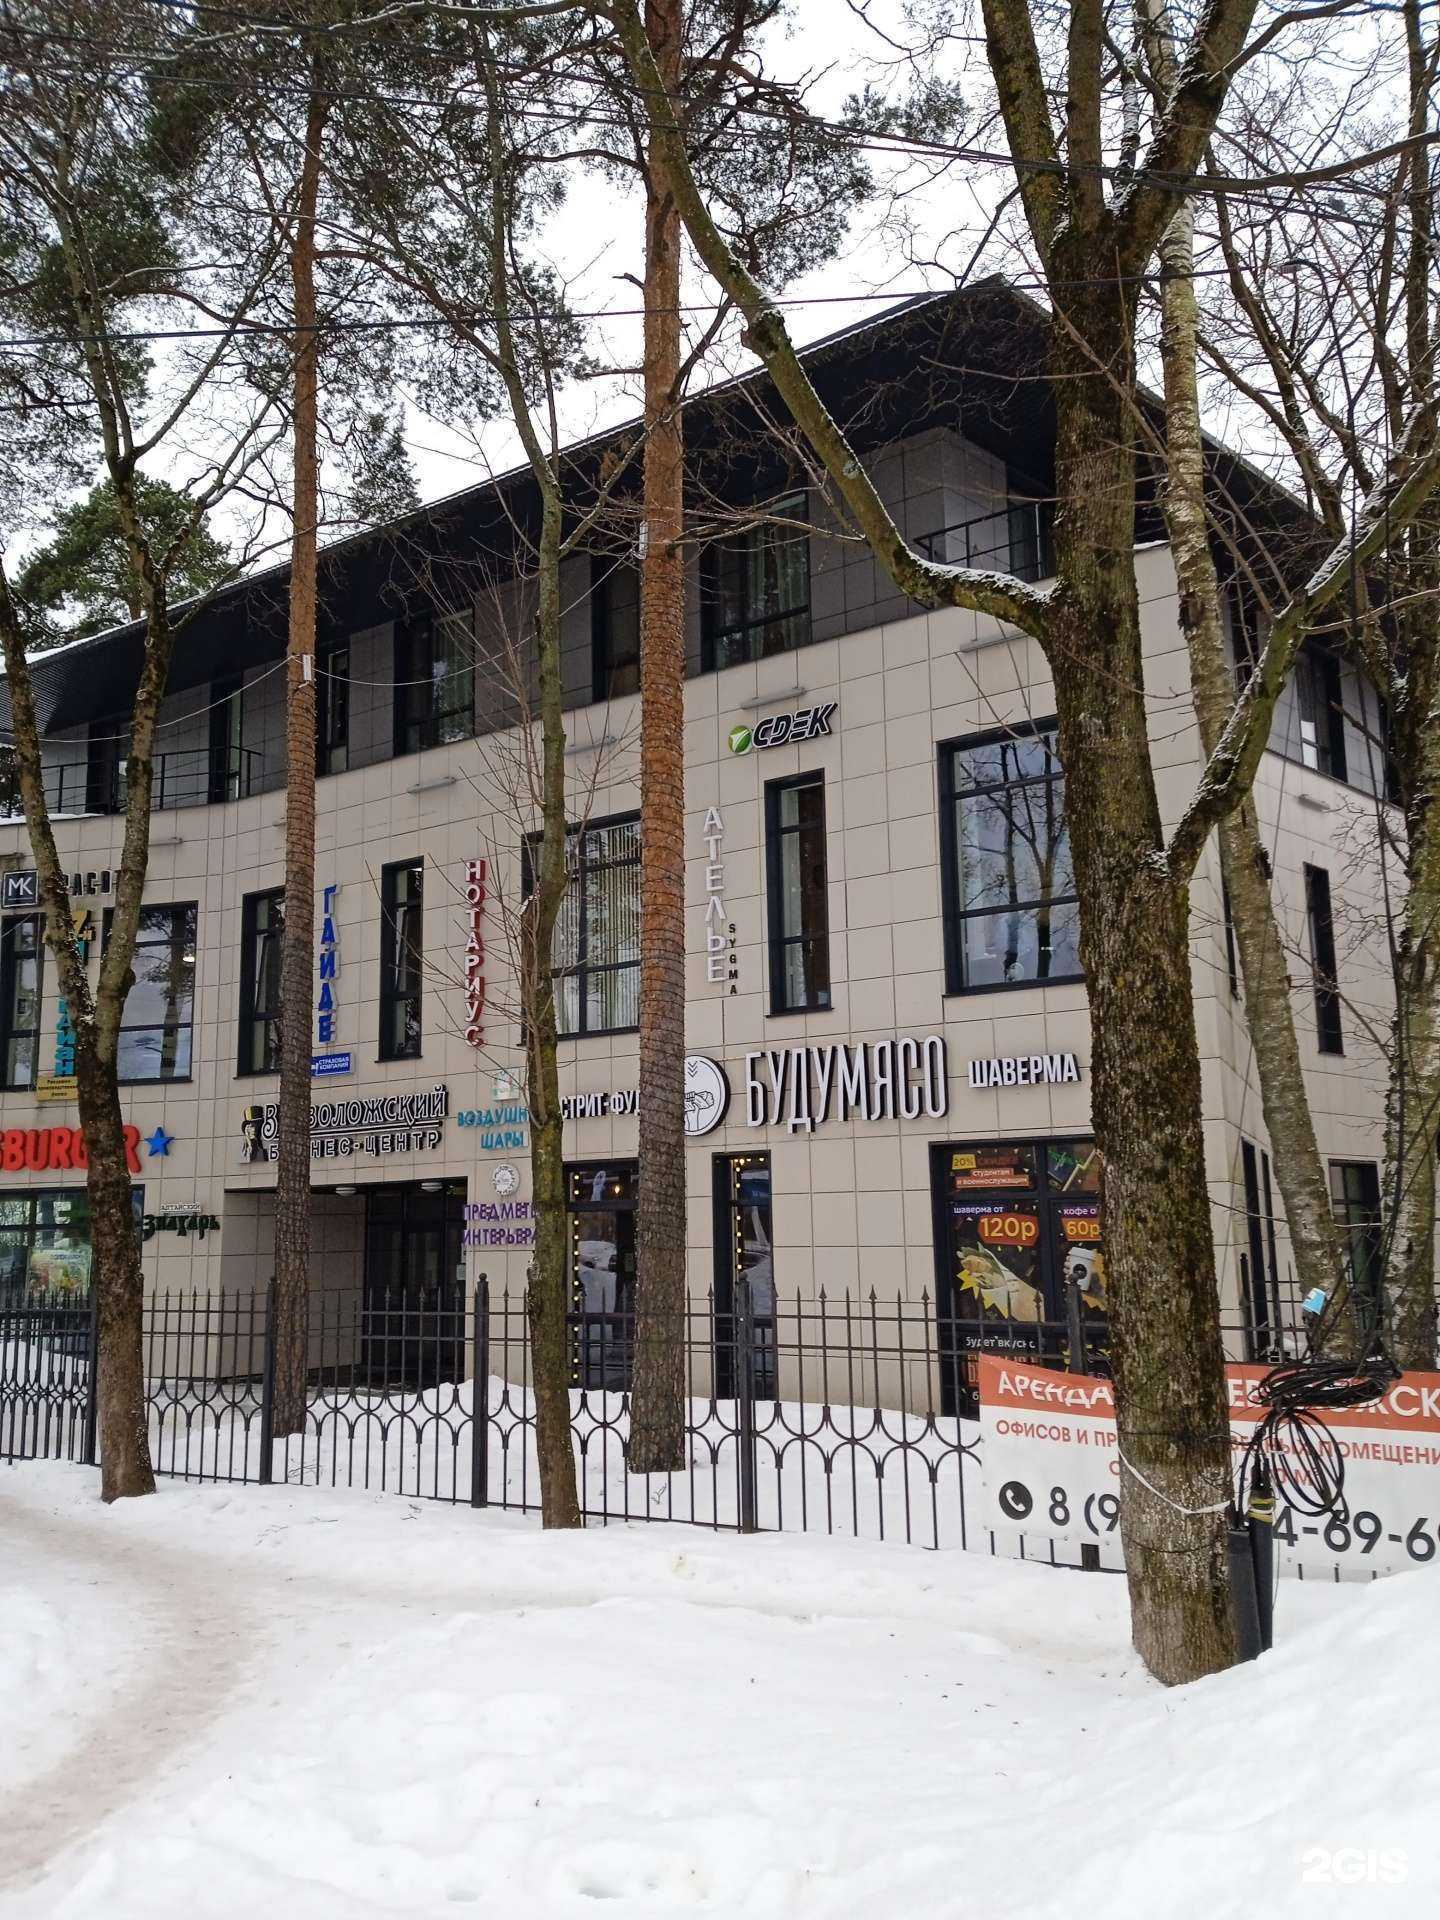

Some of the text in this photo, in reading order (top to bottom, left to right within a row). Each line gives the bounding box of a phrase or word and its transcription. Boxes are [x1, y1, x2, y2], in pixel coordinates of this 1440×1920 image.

[753, 703, 837, 749] CDEK
[703, 806, 727, 983] АТЕЛЬЕ
[464, 859, 486, 1048] НОТАРИУС
[728, 923, 738, 995] SYGMA
[745, 1035, 949, 1133] БУДУМЯСО
[968, 1053, 1081, 1088] ШАВЕРМА
[262, 1085, 447, 1140] ВВОЛОЖСКИЙ
[457, 1105, 529, 1127] ВОЗДУШН
[269, 1130, 441, 1161] БНЕС-ЦЕНТР
[480, 1131, 525, 1150] ШАРЫ
[953, 1206, 992, 1215] шаверма
[1063, 1207, 1089, 1216] кофе
[998, 1370, 1114, 1409] АРЕНДА
[996, 1419, 1071, 1442] ОФИСОВ
[1077, 1429, 1089, 1445] И
[1319, 1439, 1440, 1466] ПОМЕЩЕНИ
[1049, 1486, 1070, 1527] 8
